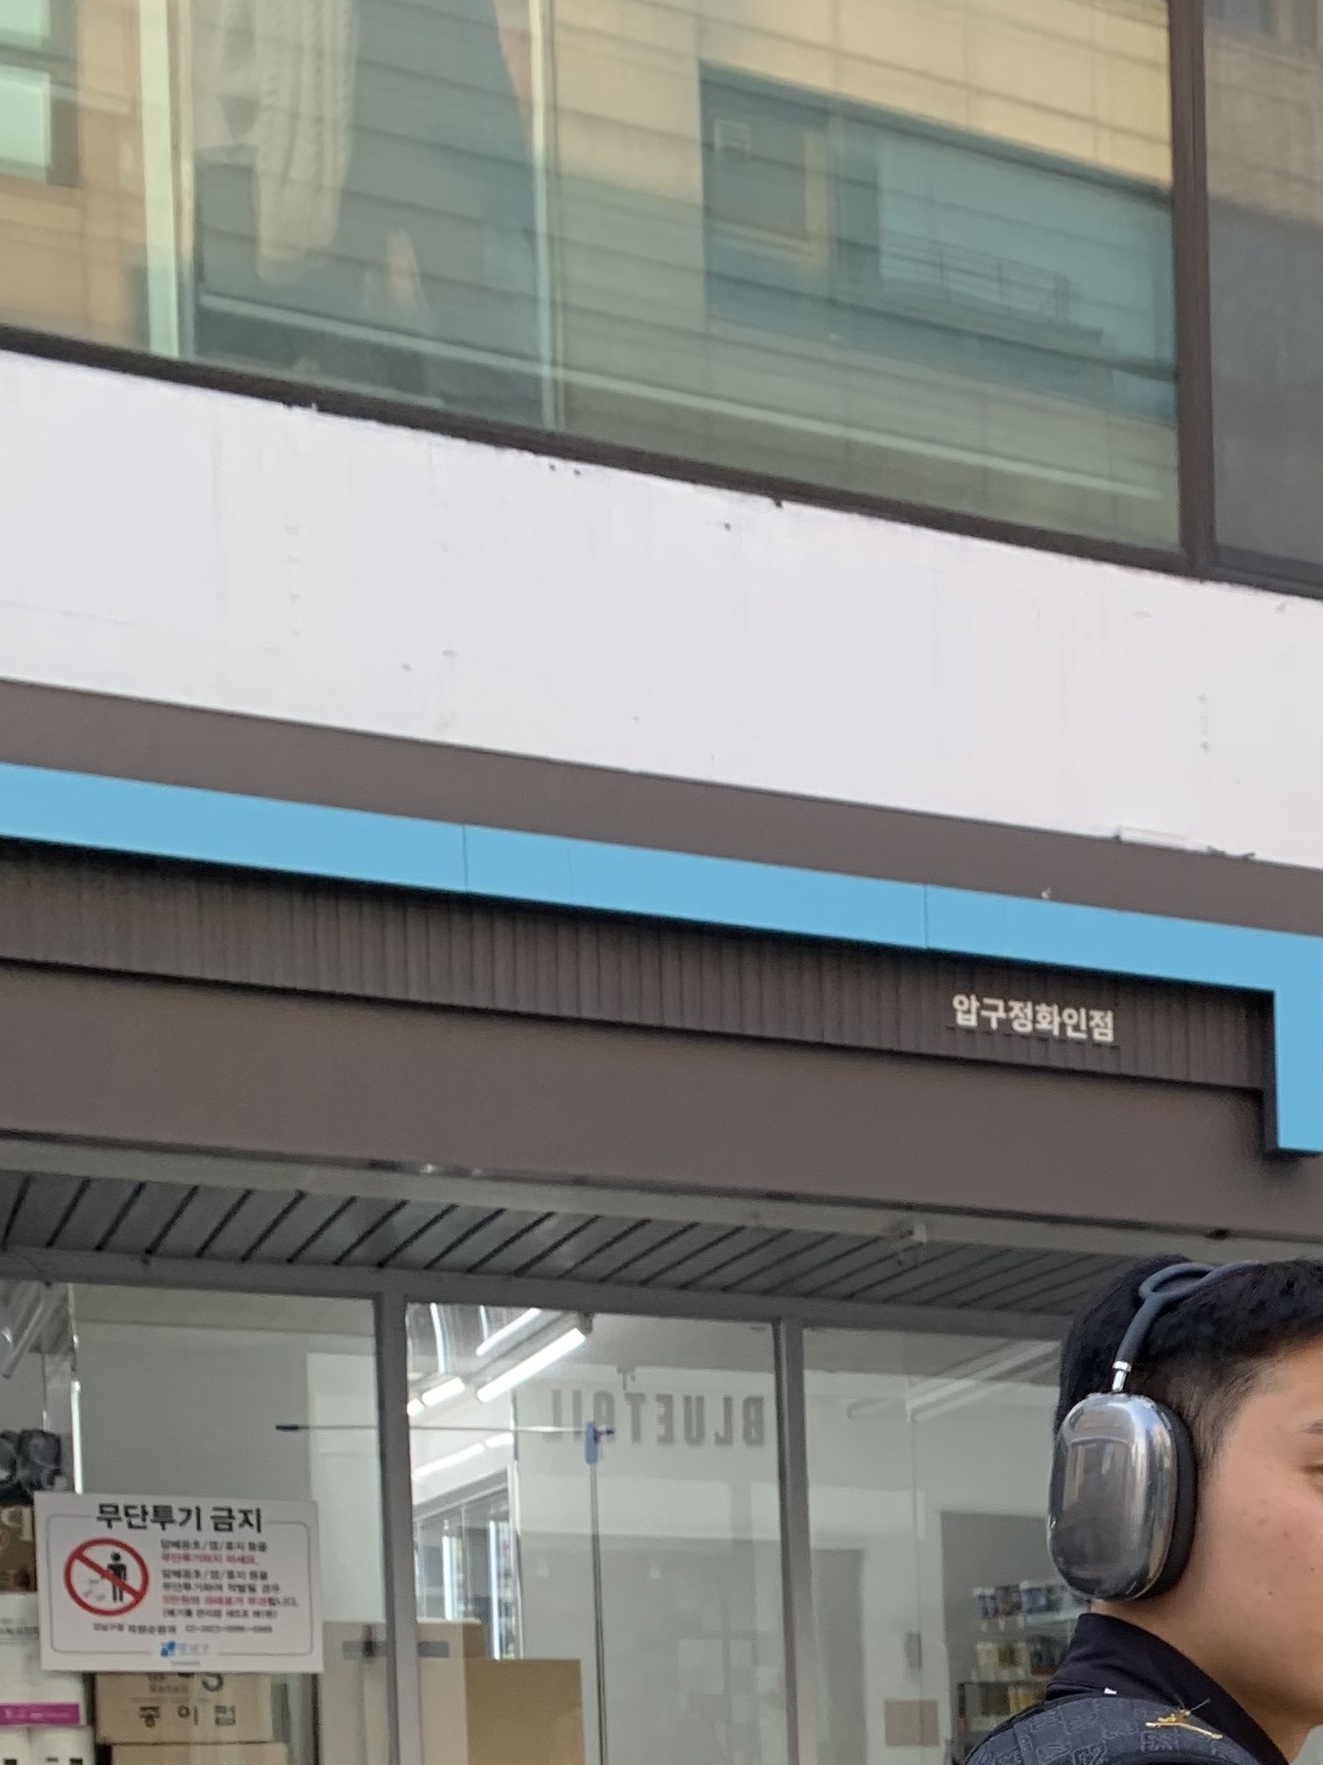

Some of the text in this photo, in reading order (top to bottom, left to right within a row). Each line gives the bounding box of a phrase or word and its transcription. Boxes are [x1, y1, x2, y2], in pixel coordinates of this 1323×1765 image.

[952, 993, 1115, 1043] 압구정화인점
[95, 1503, 263, 1533] 무단투기 금지
